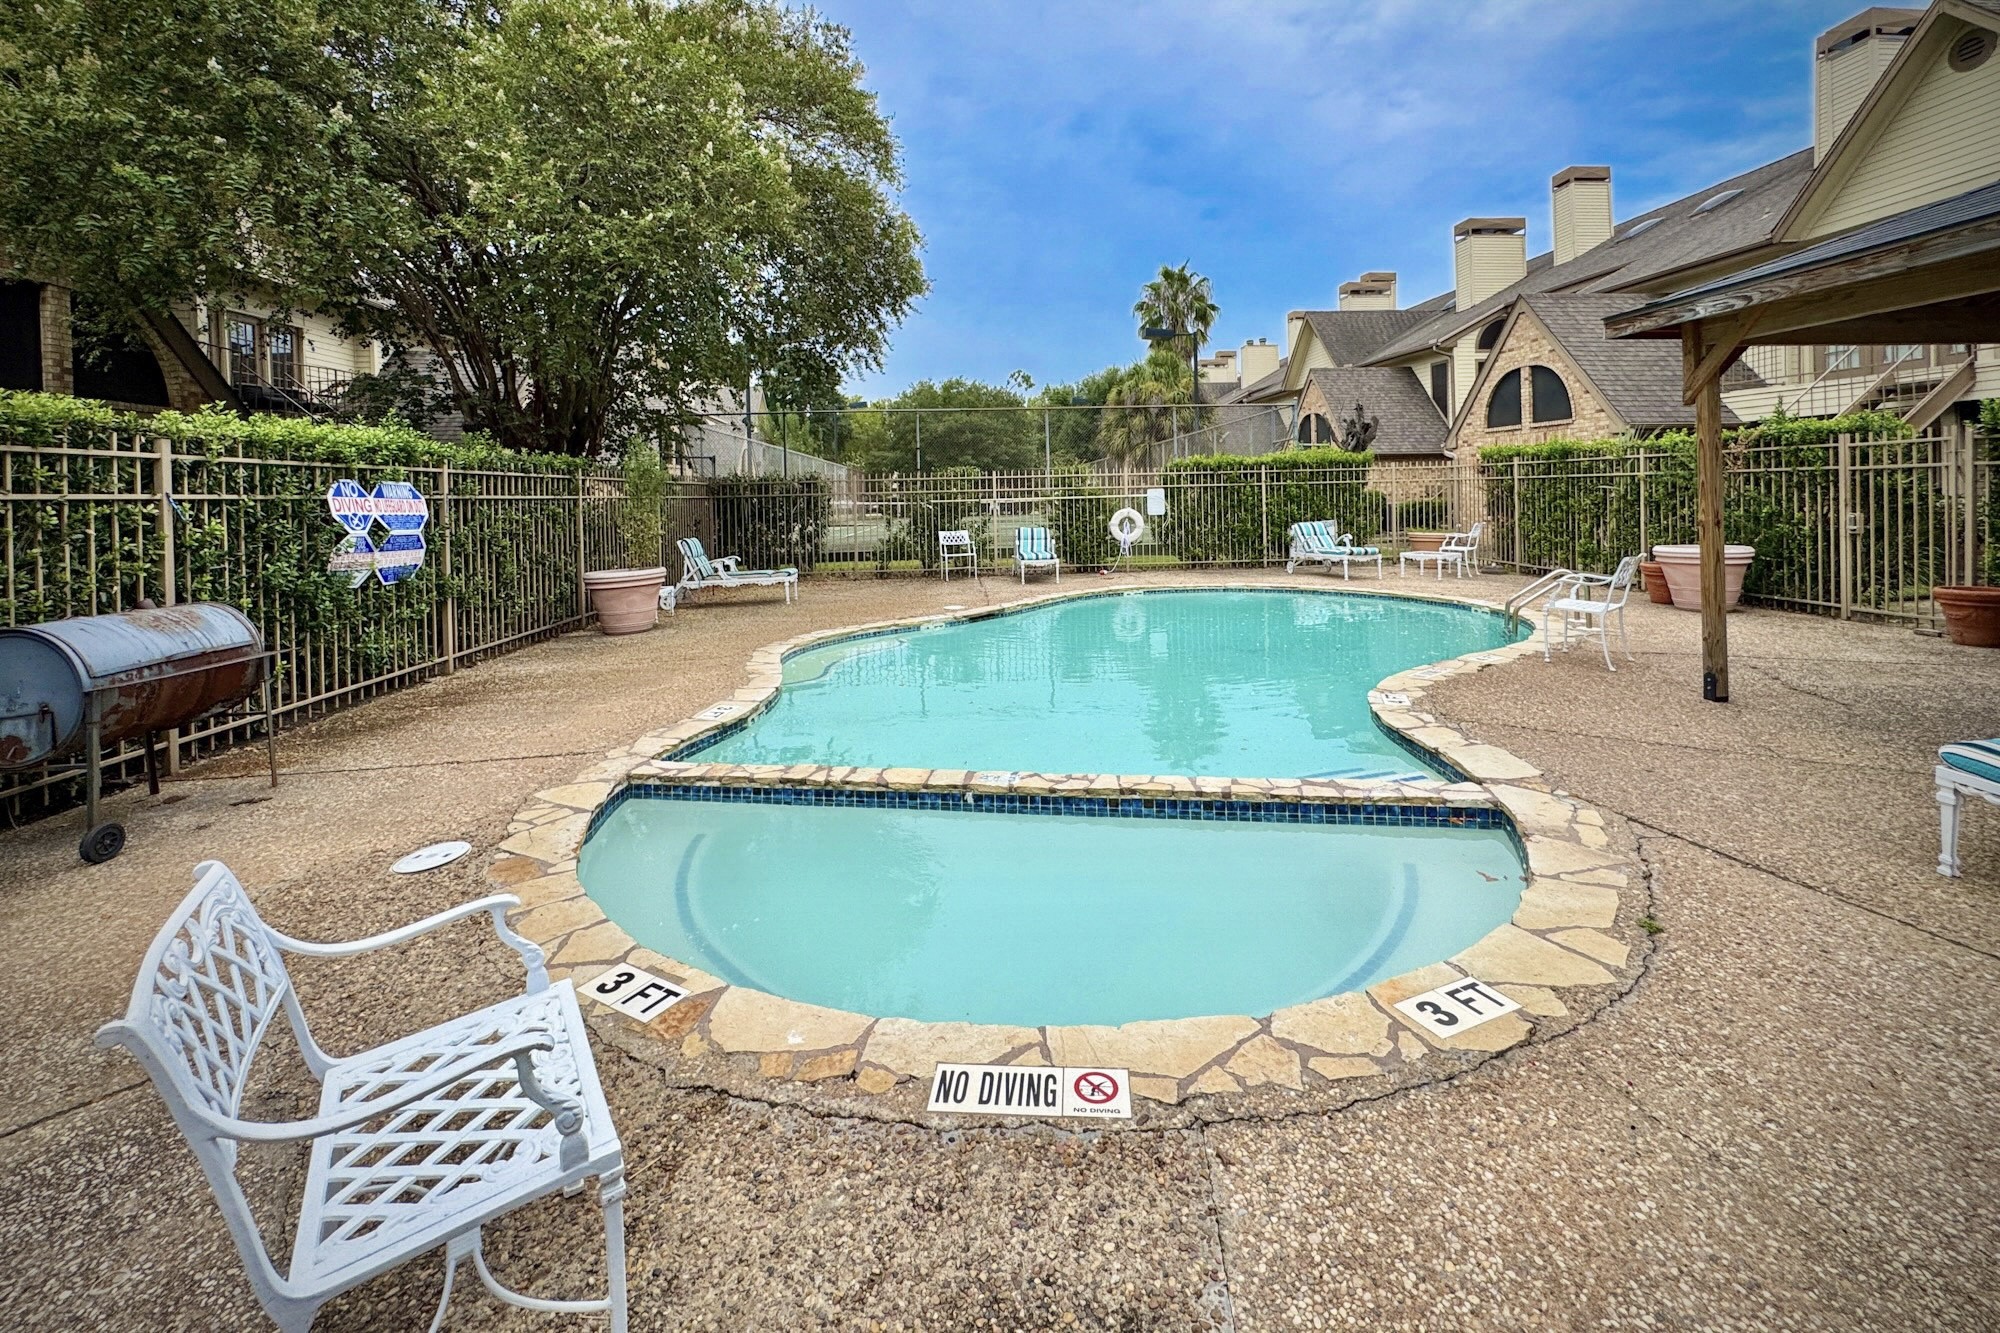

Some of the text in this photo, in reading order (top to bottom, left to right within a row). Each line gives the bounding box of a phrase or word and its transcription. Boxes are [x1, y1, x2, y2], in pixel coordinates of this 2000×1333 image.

[340, 482, 358, 497] NO
[382, 484, 413, 499] WARNING
[332, 498, 372, 512] DIVING
[596, 972, 682, 1014] 3 FT
[1416, 981, 1505, 1026] 3 FT
[935, 1070, 1057, 1107] NO DIVING
